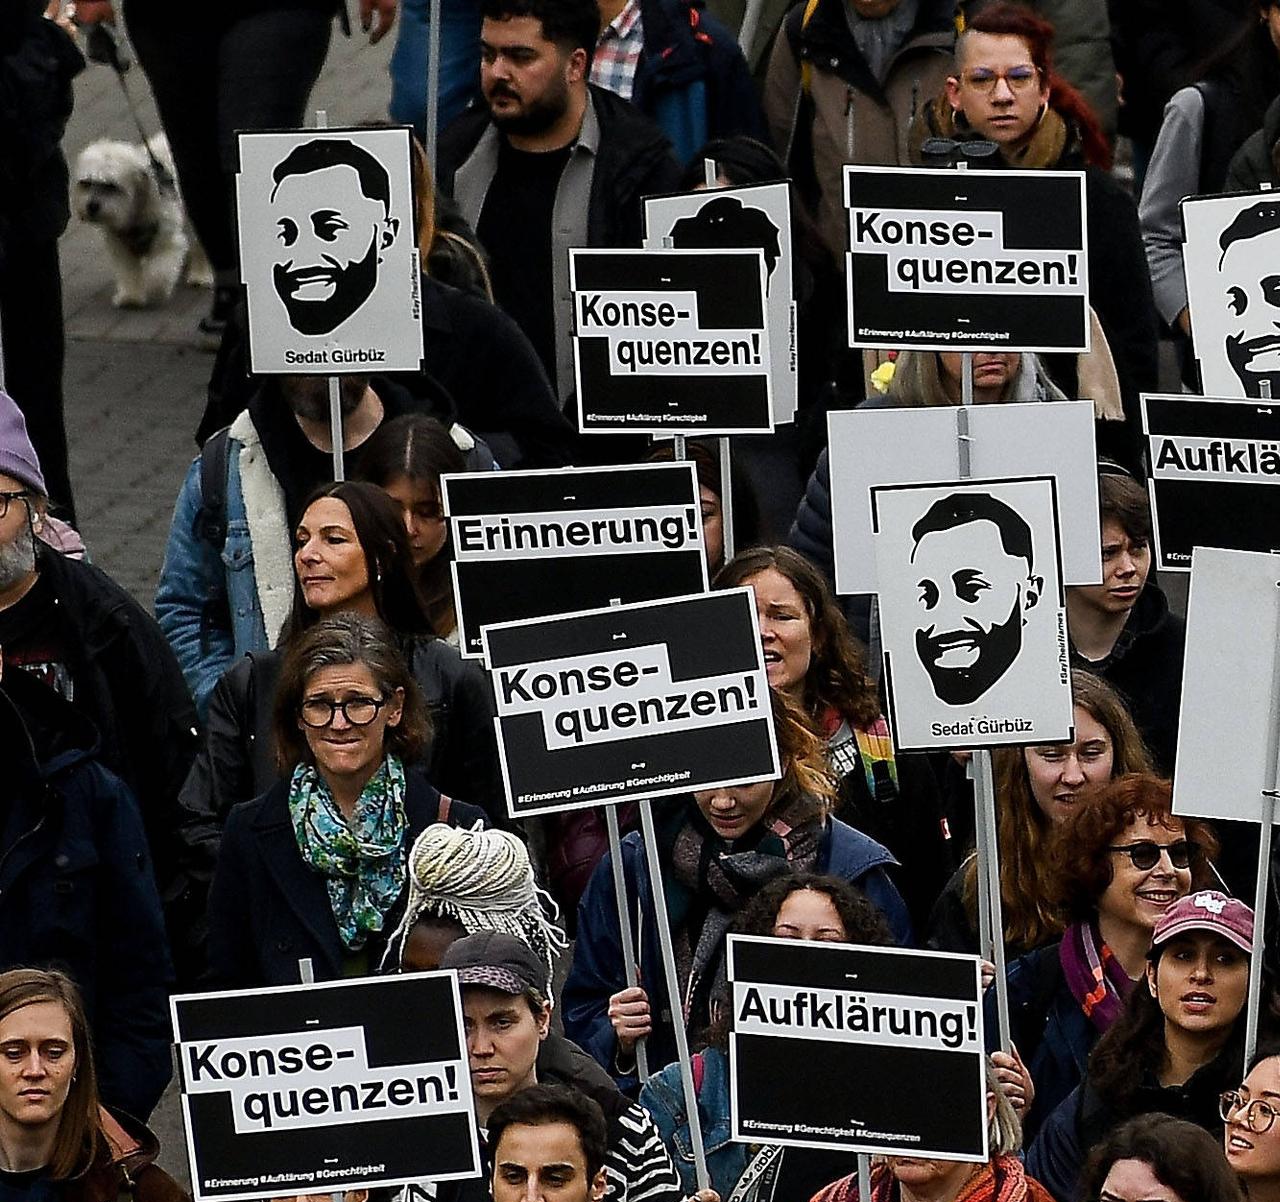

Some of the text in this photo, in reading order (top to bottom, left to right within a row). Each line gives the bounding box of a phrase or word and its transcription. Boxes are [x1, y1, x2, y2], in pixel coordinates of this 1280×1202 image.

[856, 211, 993, 246] Konse-
[897, 254, 1078, 290] quenzen!
[581, 295, 690, 327] Konse-
[285, 350, 385, 363] Sedat Gürbüz
[617, 333, 761, 372] quenzen!
[457, 508, 698, 552] Erinnerung!
[500, 660, 659, 704] Konse-
[554, 676, 758, 742] quenzen!
[932, 719, 1033, 736] Sedat Gürbüz
[739, 987, 977, 1048] Aufklärung!
[189, 1043, 354, 1081] Konse-
[244, 1065, 459, 1128] quenzen!
